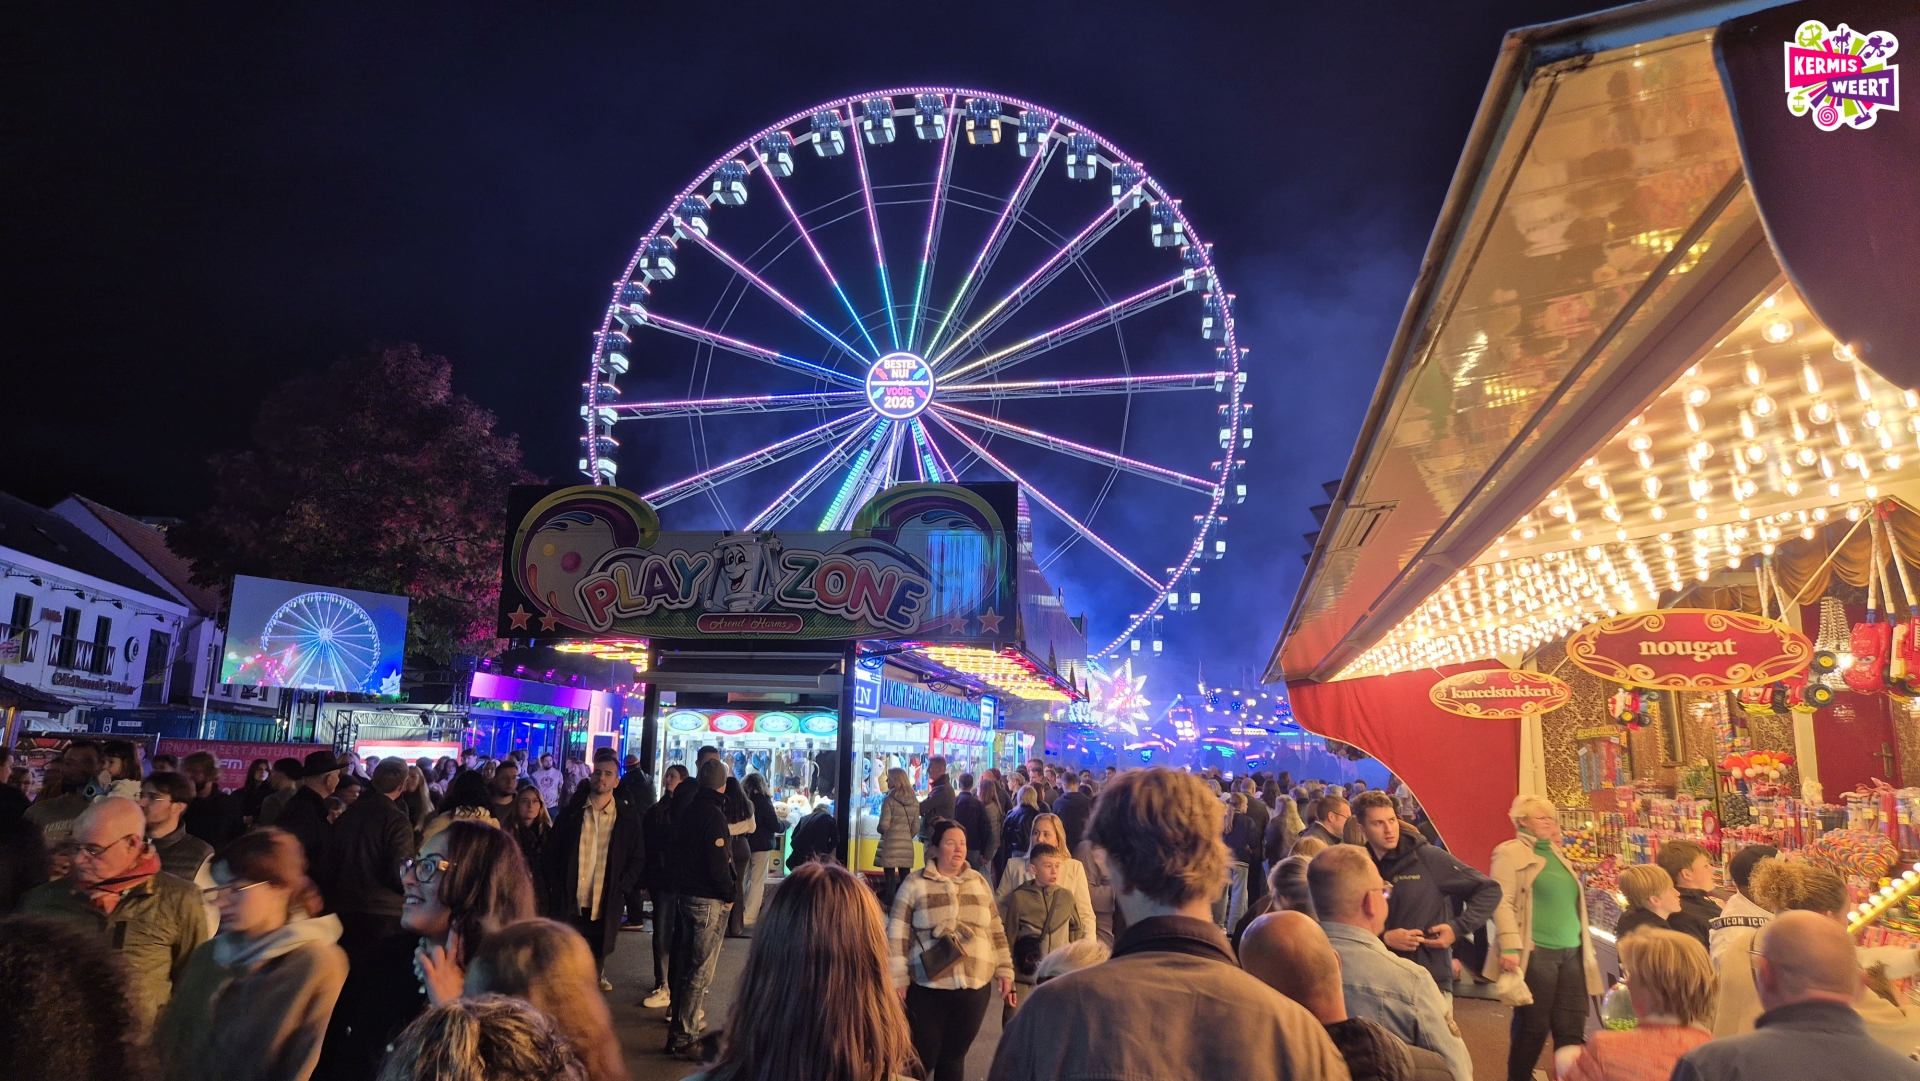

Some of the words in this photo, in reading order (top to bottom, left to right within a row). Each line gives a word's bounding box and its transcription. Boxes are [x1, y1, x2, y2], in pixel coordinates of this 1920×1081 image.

[884, 359, 918, 369] BESTEL
[886, 387, 912, 395] VOOR:
[884, 396, 915, 408] 2026
[578, 551, 713, 629] PLAY
[778, 552, 931, 631] ZONE
[709, 617, 747, 629] Arend
[751, 616, 787, 629] Harms
[1638, 638, 1738, 662] nougat
[857, 685, 872, 705] IN
[883, 678, 889, 704] U
[889, 680, 908, 708] KUNT
[908, 686, 924, 711] HIER
[1450, 685, 1552, 699] kaneelstokken
[1723, 917, 1745, 926] ICON
